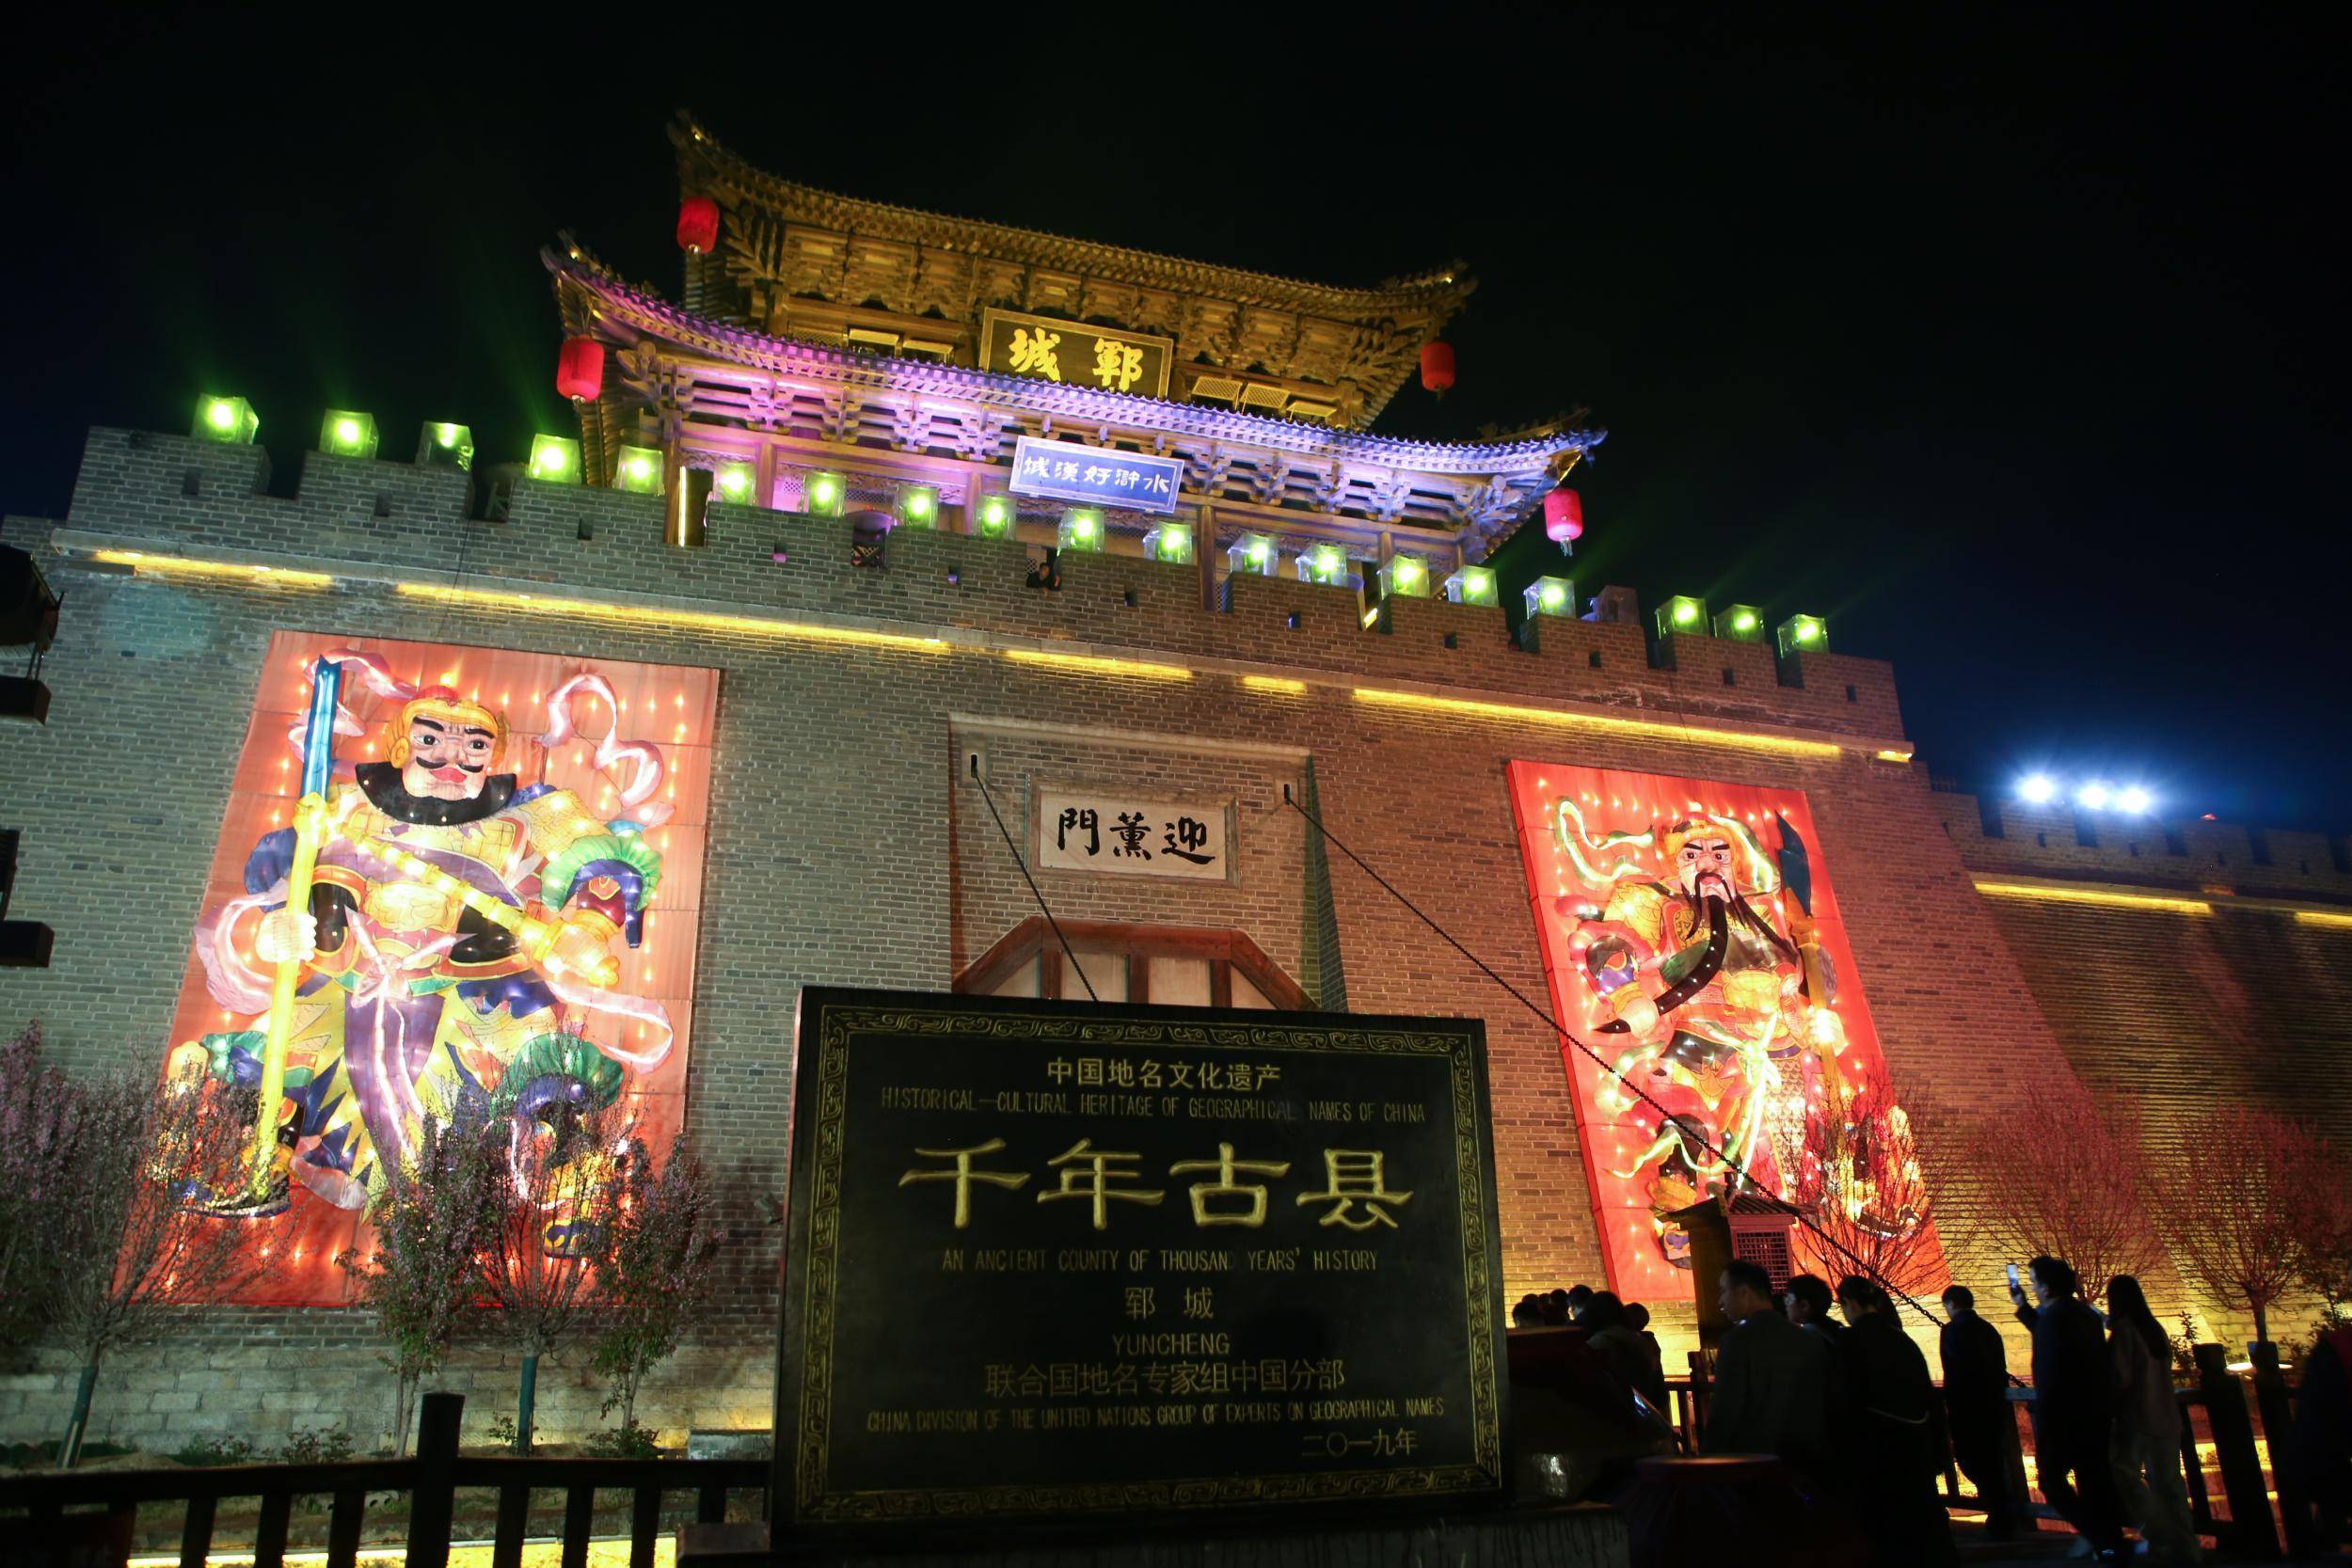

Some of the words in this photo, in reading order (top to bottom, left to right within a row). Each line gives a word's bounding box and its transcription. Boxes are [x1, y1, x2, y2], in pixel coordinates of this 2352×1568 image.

[1046, 1056, 1281, 1092] 中国地名文化遗产
[1080, 1093, 1154, 1117] HERITAGE
[1162, 1097, 1180, 1118] OF
[1188, 1097, 1295, 1121] GEOGRAPHICAL
[1309, 1101, 1352, 1122] NAMES
[1359, 1101, 1376, 1121] OF
[1383, 1102, 1426, 1123] CHINA
[898, 1136, 1414, 1230] 千年古县
[942, 1249, 964, 1271] AN
[975, 1249, 1046, 1271] ANCIENT
[1058, 1249, 1120, 1271] COUNTY
[1129, 1249, 1150, 1271] OF
[1313, 1250, 1378, 1271] HISTORY
[1124, 1286, 1215, 1320] 郓城
[1112, 1332, 1231, 1356] YUNCHENG
[984, 1359, 1346, 1398] 联合国地名专家组中国分部
[866, 1411, 912, 1433] CHINA
[916, 1411, 978, 1433] DIVISION
[985, 1410, 1002, 1430] OF
[1010, 1409, 1035, 1430] THE
[1041, 1408, 1091, 1430] UNITED
[1097, 1405, 1152, 1428] NATIONS
[1157, 1403, 1197, 1426] GROUP
[1201, 1403, 1217, 1426] OF
[1226, 1402, 1281, 1424] EXPERTS
[1287, 1400, 1305, 1422] ON
[1309, 1398, 1400, 1421] GEOGRAPHICAL
[1406, 1396, 1446, 1418] NAMES
